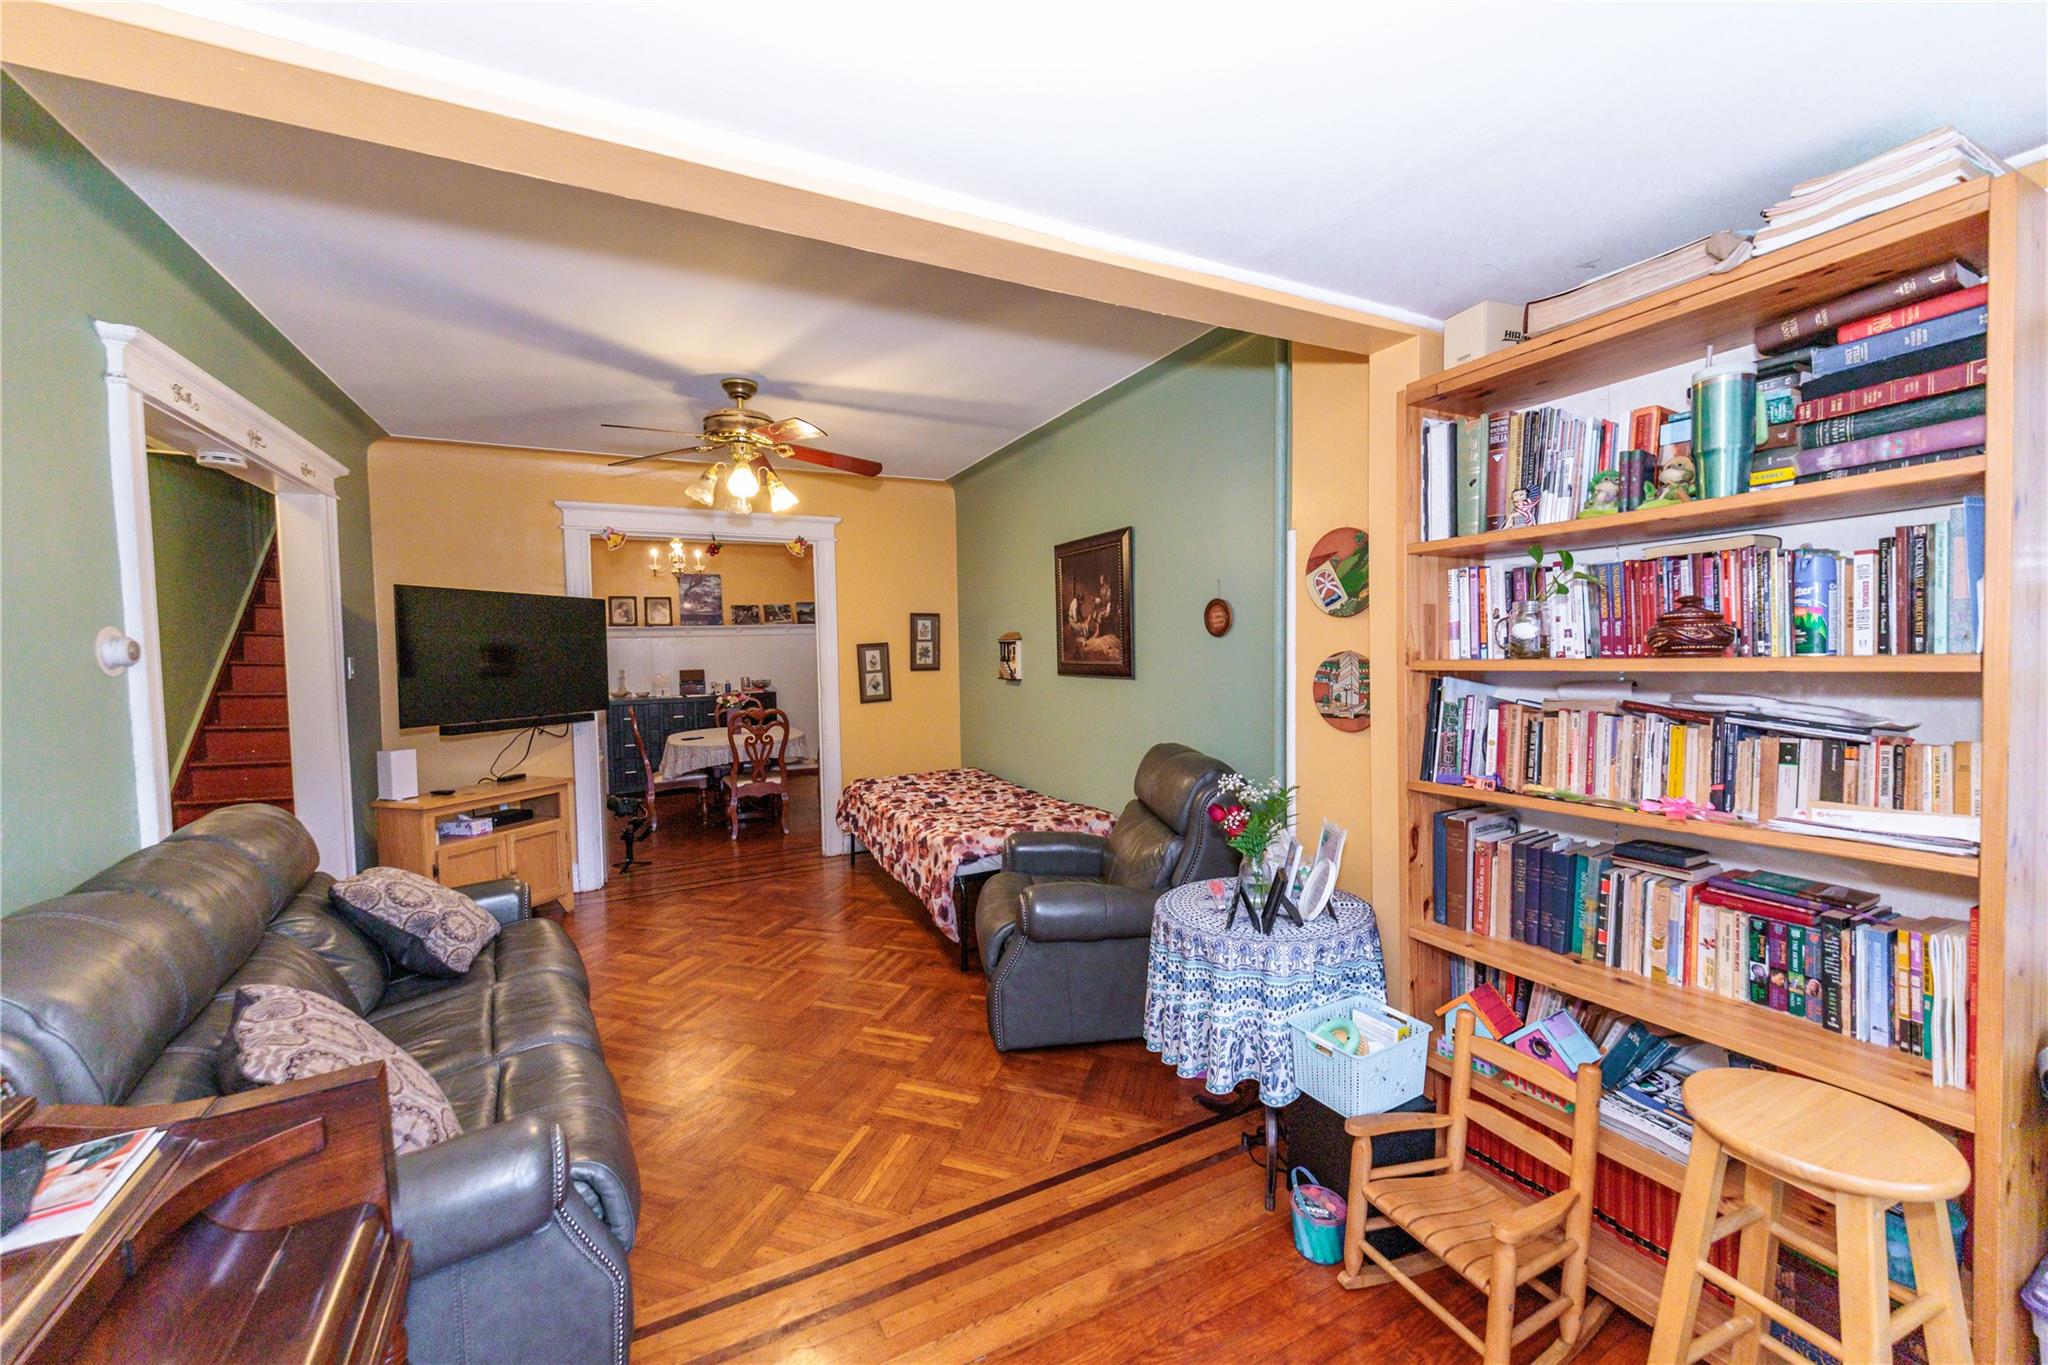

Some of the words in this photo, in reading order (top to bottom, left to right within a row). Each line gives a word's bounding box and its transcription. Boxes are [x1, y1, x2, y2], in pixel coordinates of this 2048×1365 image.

[1915, 538, 1924, 566] ENCIENDE
[1856, 609, 1870, 631] BIBLIA
[1914, 597, 1923, 621] MARCOS
[1914, 621, 1923, 636] WITT
[1791, 940, 1799, 951] THE
[1791, 951, 1799, 973] HOBBIT
[1831, 936, 1840, 984] APOCALIPSIS
[1828, 987, 1837, 1016] LAHAYE
